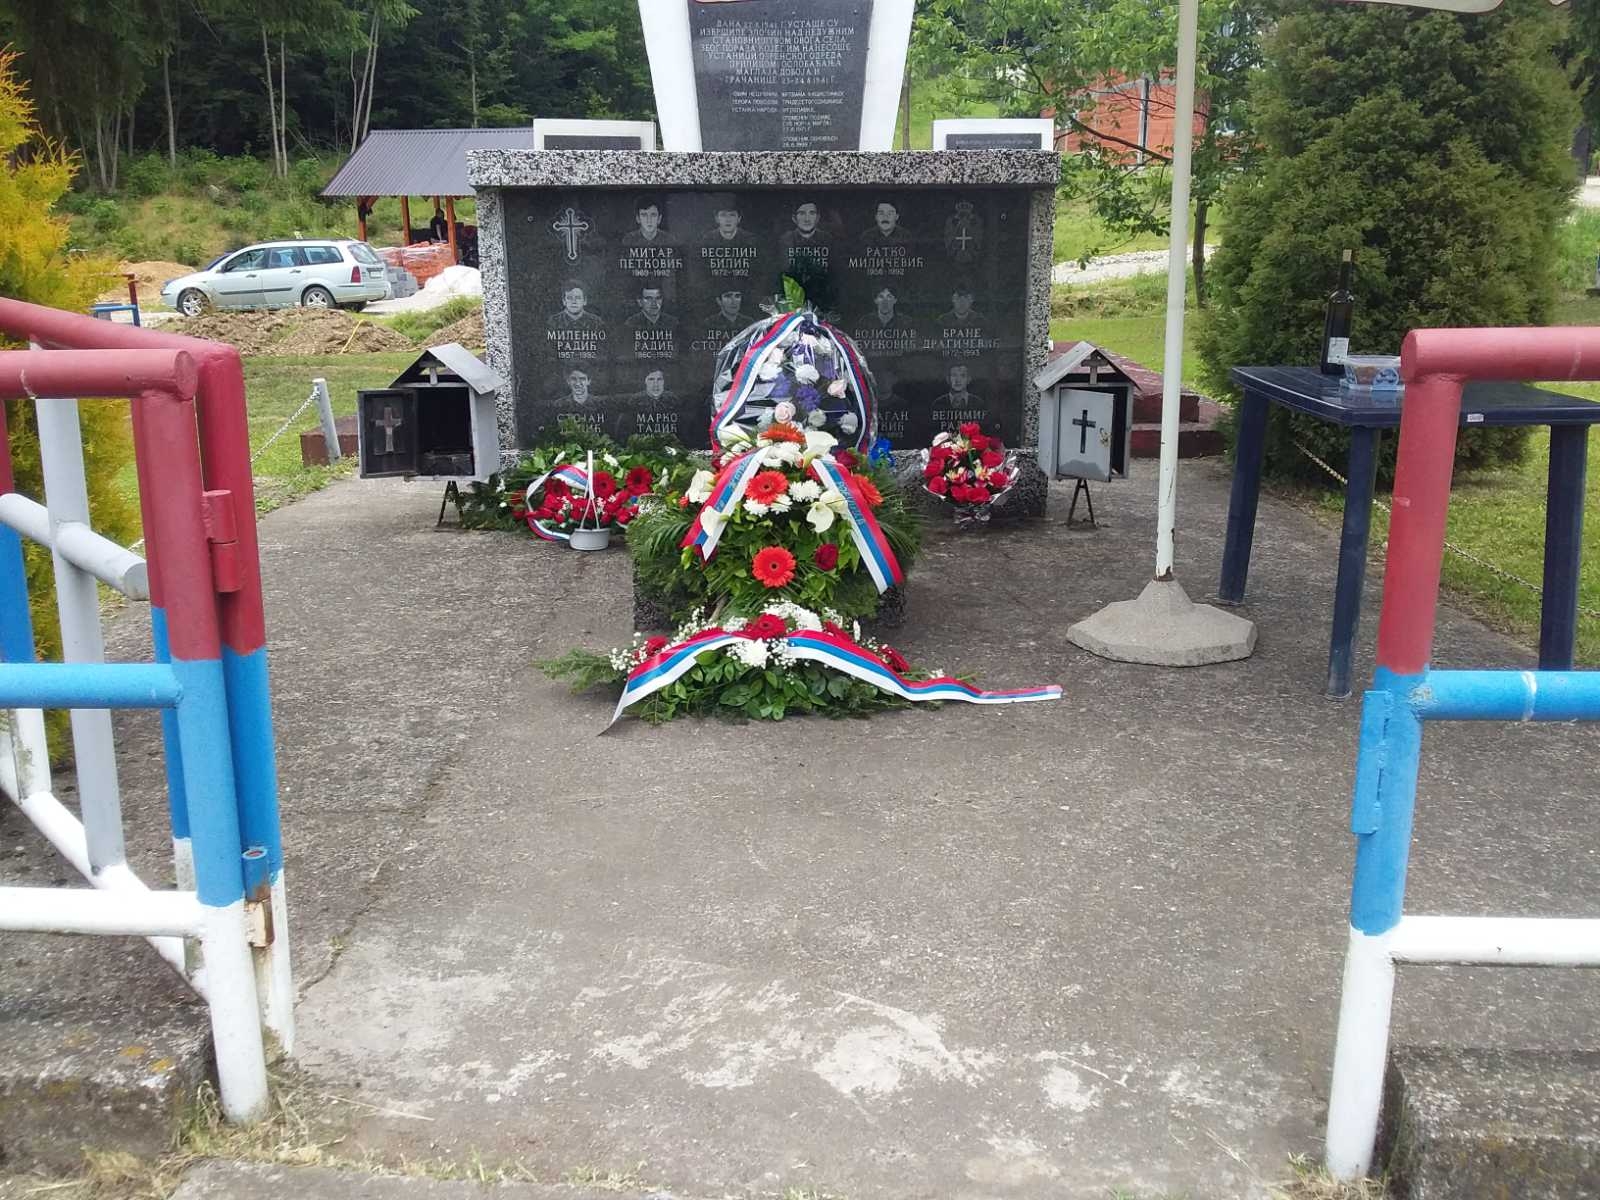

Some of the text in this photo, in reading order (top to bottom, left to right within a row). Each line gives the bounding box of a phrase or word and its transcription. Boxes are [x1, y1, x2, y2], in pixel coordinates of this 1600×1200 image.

[629, 247, 674, 258] МИТАР
[701, 247, 757, 258] ВЕСЕЛИН
[866, 246, 906, 257] РАТКО
[619, 258, 683, 269] ПЕТКОВИЋ
[710, 258, 750, 269] БИЛИЋ
[848, 256, 925, 268] МИЛИЧЕВИЋ
[547, 330, 606, 341] МИЛЕНКО
[634, 330, 673, 341] ВОЈИН
[943, 327, 983, 339] БРАНЕ
[557, 341, 597, 351] РАДИЋ
[634, 340, 675, 351] РАДИЋ
[636, 412, 679, 423] МАРКО
[636, 423, 679, 433] ТАДИЋ
